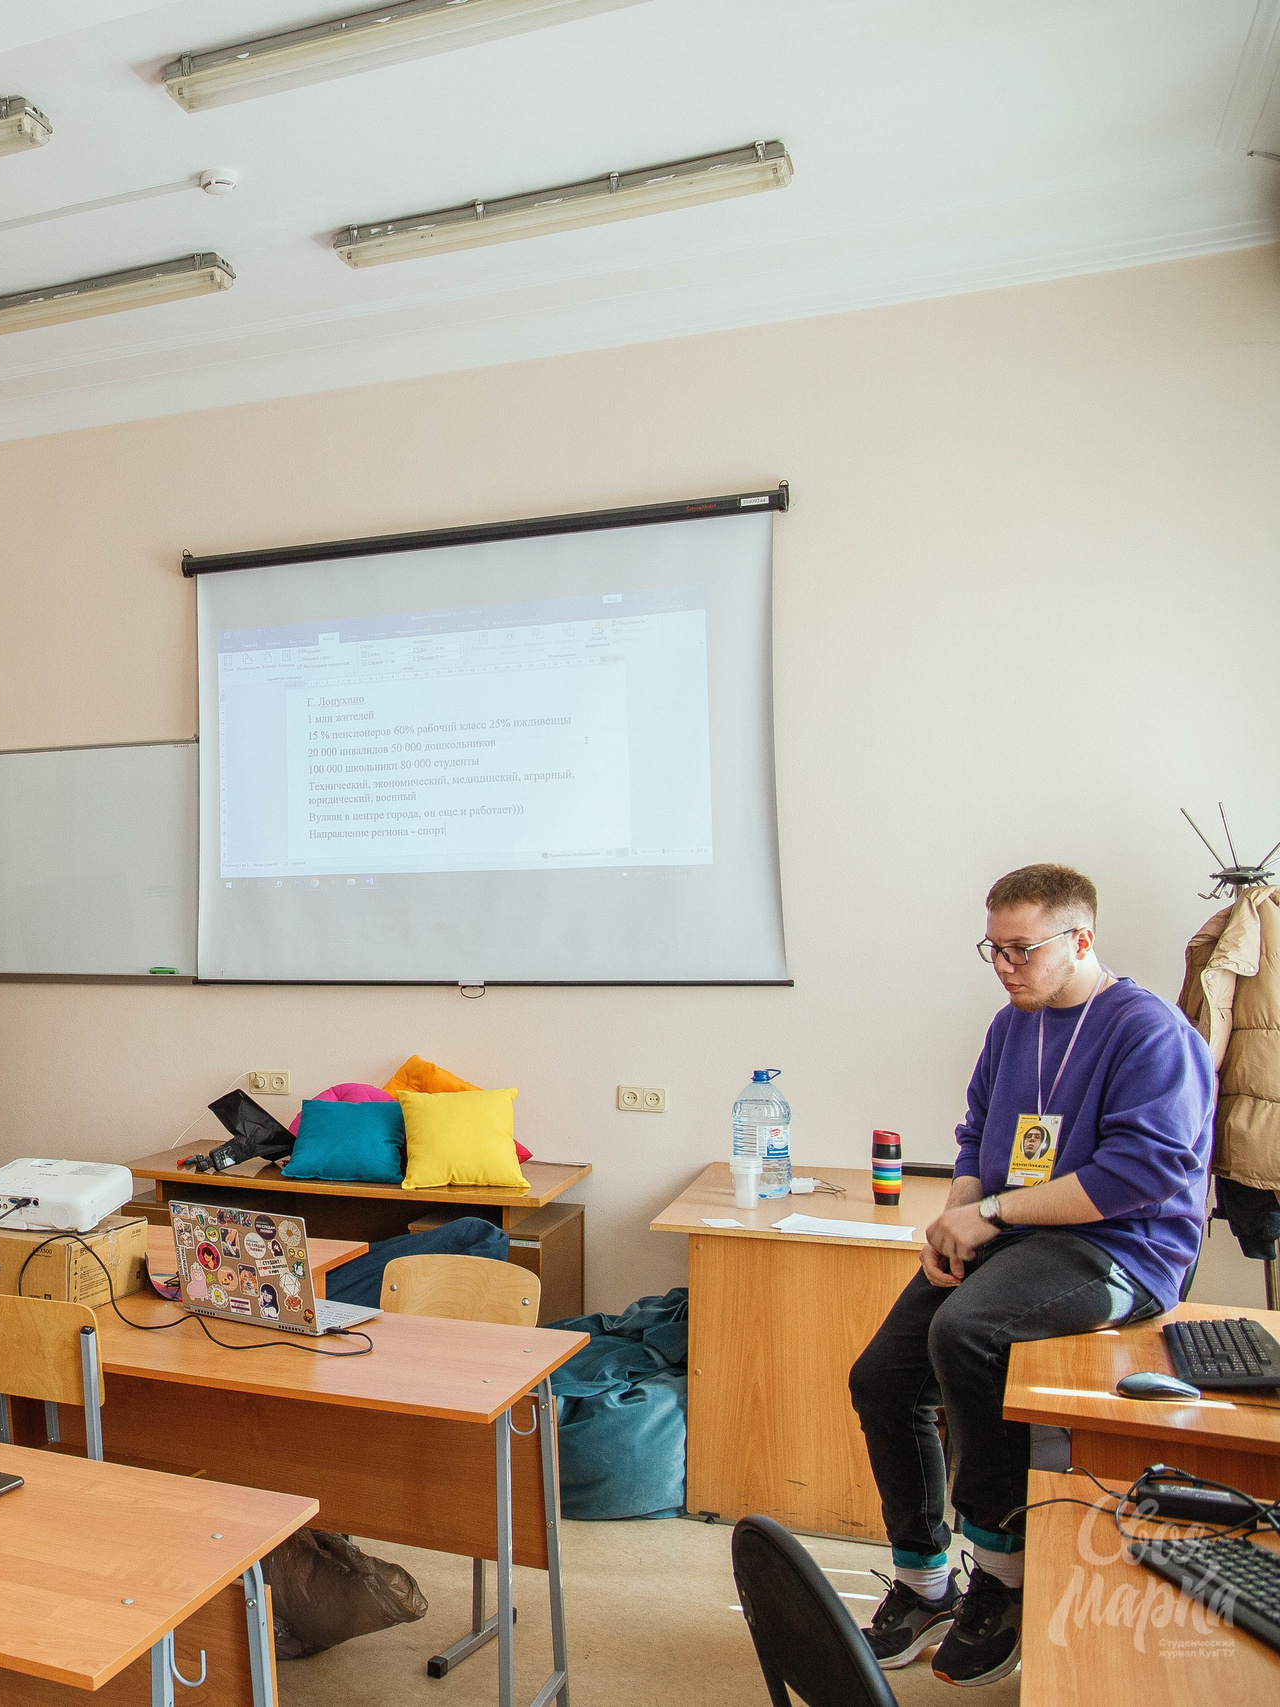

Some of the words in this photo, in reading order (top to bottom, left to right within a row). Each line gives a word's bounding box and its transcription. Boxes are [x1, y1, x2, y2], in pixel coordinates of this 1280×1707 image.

[307, 697, 316, 707] Г.
[318, 696, 365, 708] Лопухино
[308, 714, 312, 724] 1
[315, 715, 332, 724] млн
[335, 710, 374, 722] жителей
[308, 731, 318, 740] 15
[320, 730, 330, 740] %
[332, 728, 392, 740] пенсионеров
[394, 724, 414, 736] 60%
[417, 722, 457, 736] рабочий
[460, 722, 486, 731] класс
[488, 718, 510, 729] 25%
[514, 716, 572, 728] иждивенцы
[308, 748, 318, 758] 20
[320, 747, 338, 757] 000
[340, 744, 388, 756] инвалидов
[390, 743, 402, 754] 50
[404, 742, 422, 752] 000
[424, 738, 496, 752] дошкольников
[308, 765, 324, 774] 100
[326, 764, 342, 774] 000
[345, 761, 398, 773] школьники
[400, 760, 412, 770] 80
[414, 759, 431, 769] 000
[434, 757, 480, 770] студенты
[308, 780, 370, 792] Технический,
[373, 776, 450, 789] экономический,
[452, 772, 522, 785] медицинский,
[524, 769, 576, 783] аграрный,
[308, 794, 373, 806] юридический,
[376, 791, 417, 803] военный
[309, 812, 342, 824] Вулкан
[352, 812, 384, 823] центре
[386, 812, 422, 822] города,
[438, 810, 458, 818] еще
[470, 804, 524, 818] работает)))
[309, 829, 369, 841] Направление
[372, 828, 409, 840] региона
[417, 826, 446, 839] спорт
